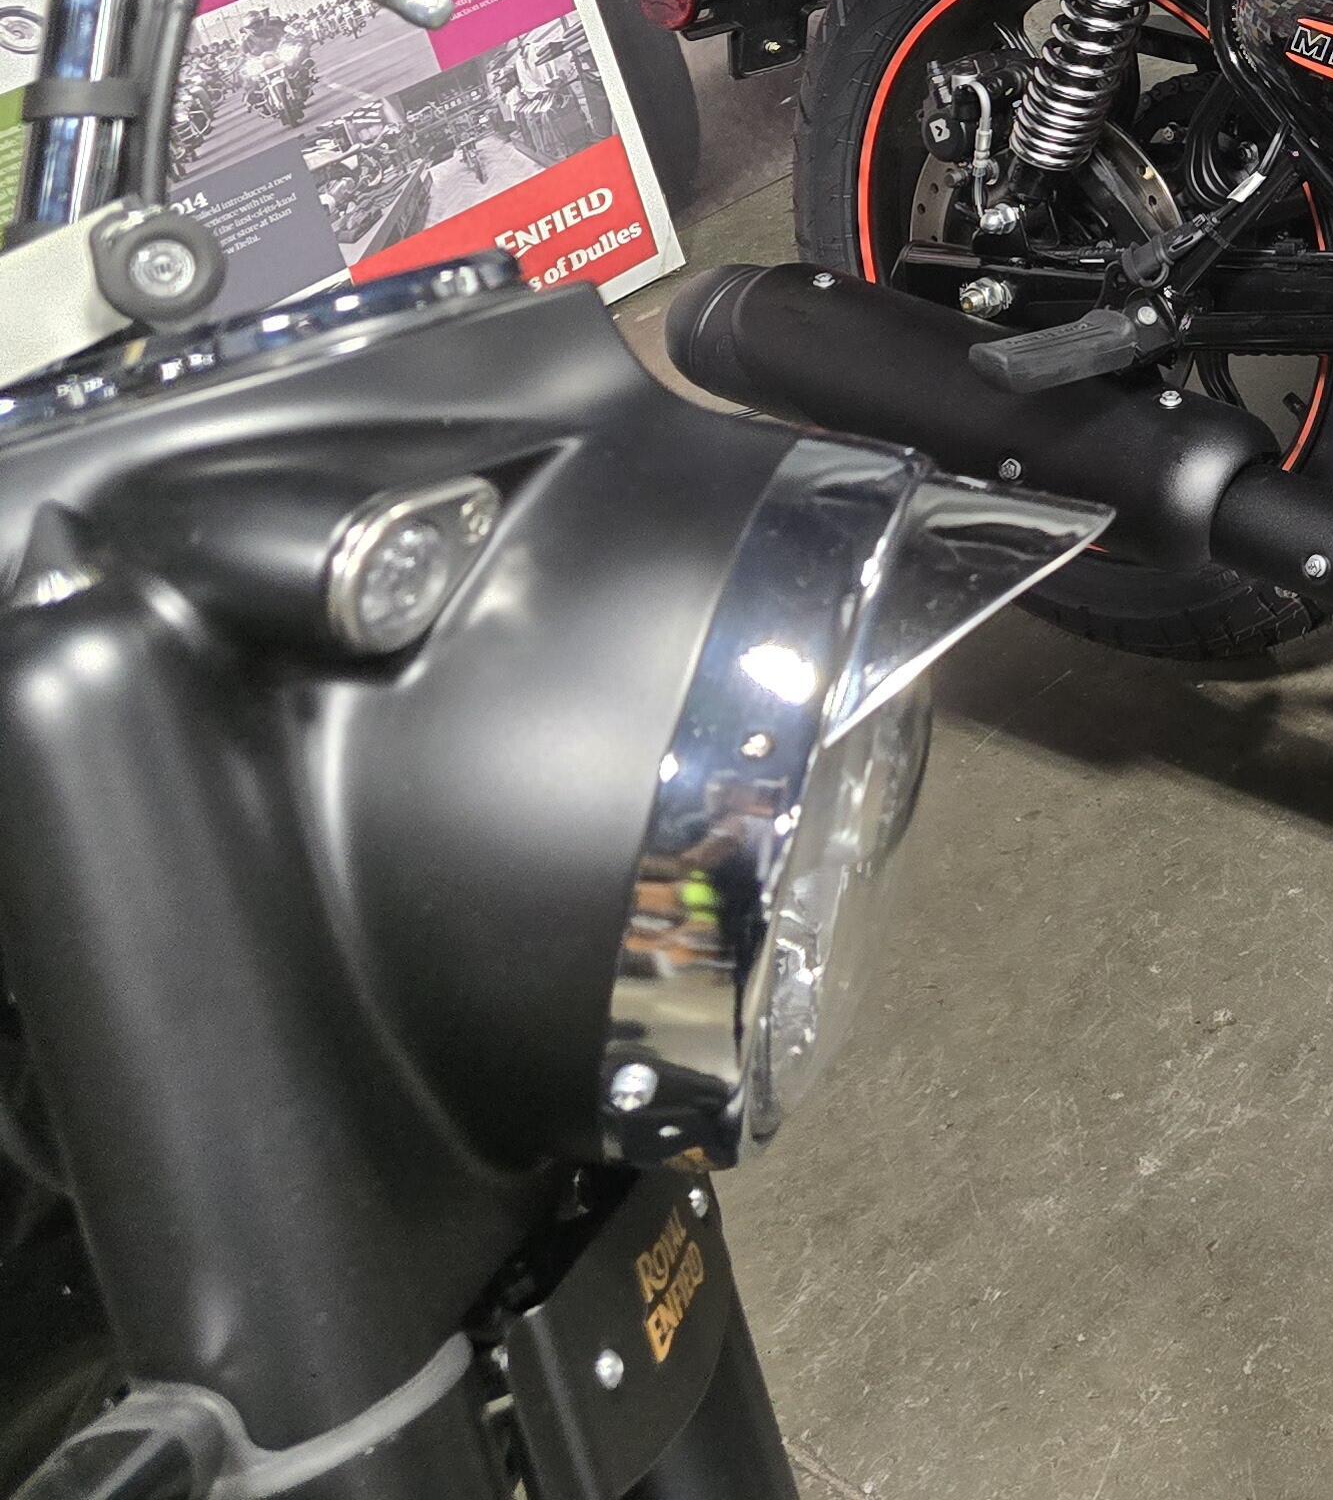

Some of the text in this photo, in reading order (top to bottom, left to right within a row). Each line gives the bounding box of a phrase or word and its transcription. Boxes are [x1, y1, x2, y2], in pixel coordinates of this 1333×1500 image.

[169, 192, 208, 215] 014
[221, 185, 267, 210] introduces
[274, 173, 292, 186] new
[239, 199, 260, 212] with
[269, 208, 292, 223] Khan
[494, 187, 613, 259] ENFIELD
[543, 259, 569, 285] of
[568, 222, 643, 272] Dulles
